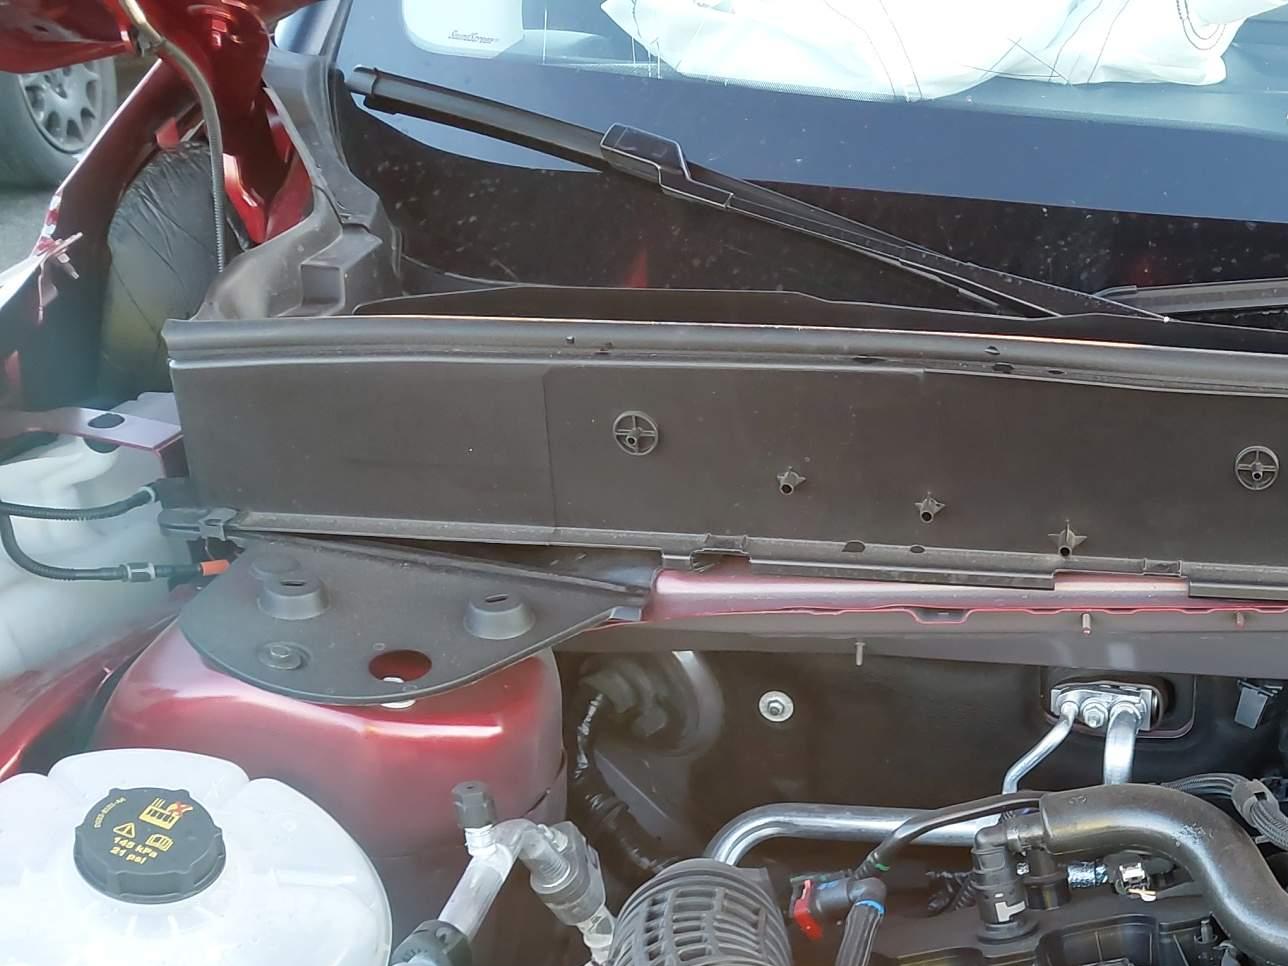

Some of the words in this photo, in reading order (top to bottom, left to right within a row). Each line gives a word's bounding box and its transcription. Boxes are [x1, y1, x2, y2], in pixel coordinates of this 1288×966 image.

[109, 846, 127, 857] 21
[125, 853, 148, 865] psi
[113, 836, 137, 850] 145
[134, 844, 158, 858] kPa
